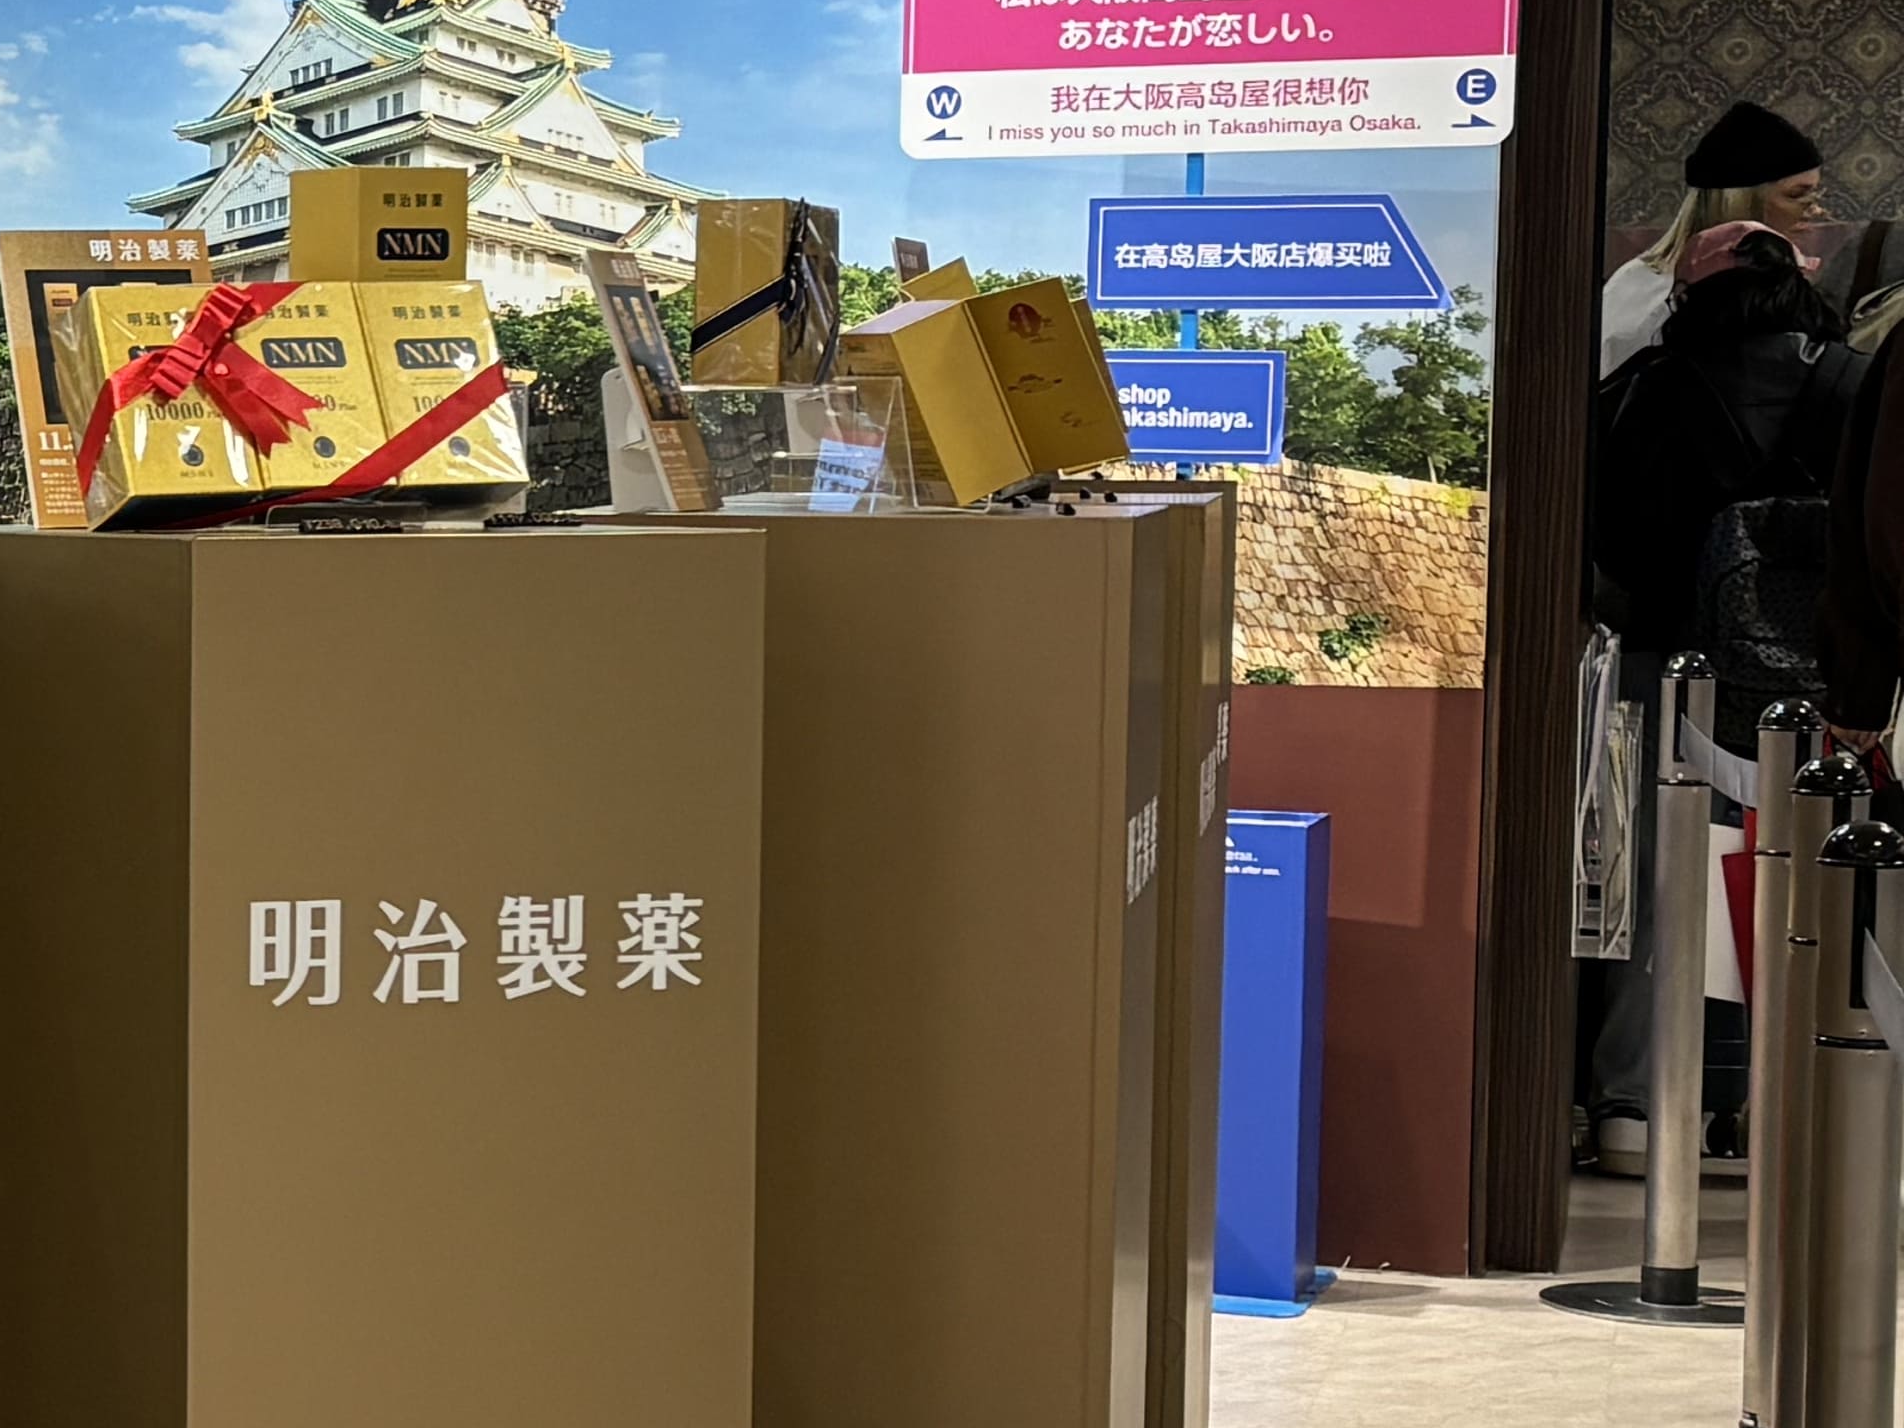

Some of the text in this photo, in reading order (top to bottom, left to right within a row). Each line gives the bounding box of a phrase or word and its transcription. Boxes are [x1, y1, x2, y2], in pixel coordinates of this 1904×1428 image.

[1058, 12, 1334, 51] あなたが恋しい。
[1051, 76, 1369, 113] 我在大阪高岛屋很想你
[1467, 75, 1485, 99] E
[930, 94, 959, 115] W
[999, 124, 1045, 140] miss
[1051, 125, 1086, 144] you
[1092, 123, 1115, 138] so
[1121, 119, 1178, 138] much
[1183, 119, 1201, 135] in
[1208, 116, 1343, 136] Takashimaya
[1350, 114, 1421, 134] Osaka.
[383, 193, 444, 207] 明治製薬
[89, 238, 201, 262] 明治製薬
[384, 233, 442, 256] NMN
[1114, 242, 1392, 268] 在高岛屋大阪店爆买啦
[392, 305, 462, 320] 明治製薬
[269, 342, 337, 364] NMN
[1118, 384, 1171, 406] shop
[248, 892, 704, 1007] 明治製薬
